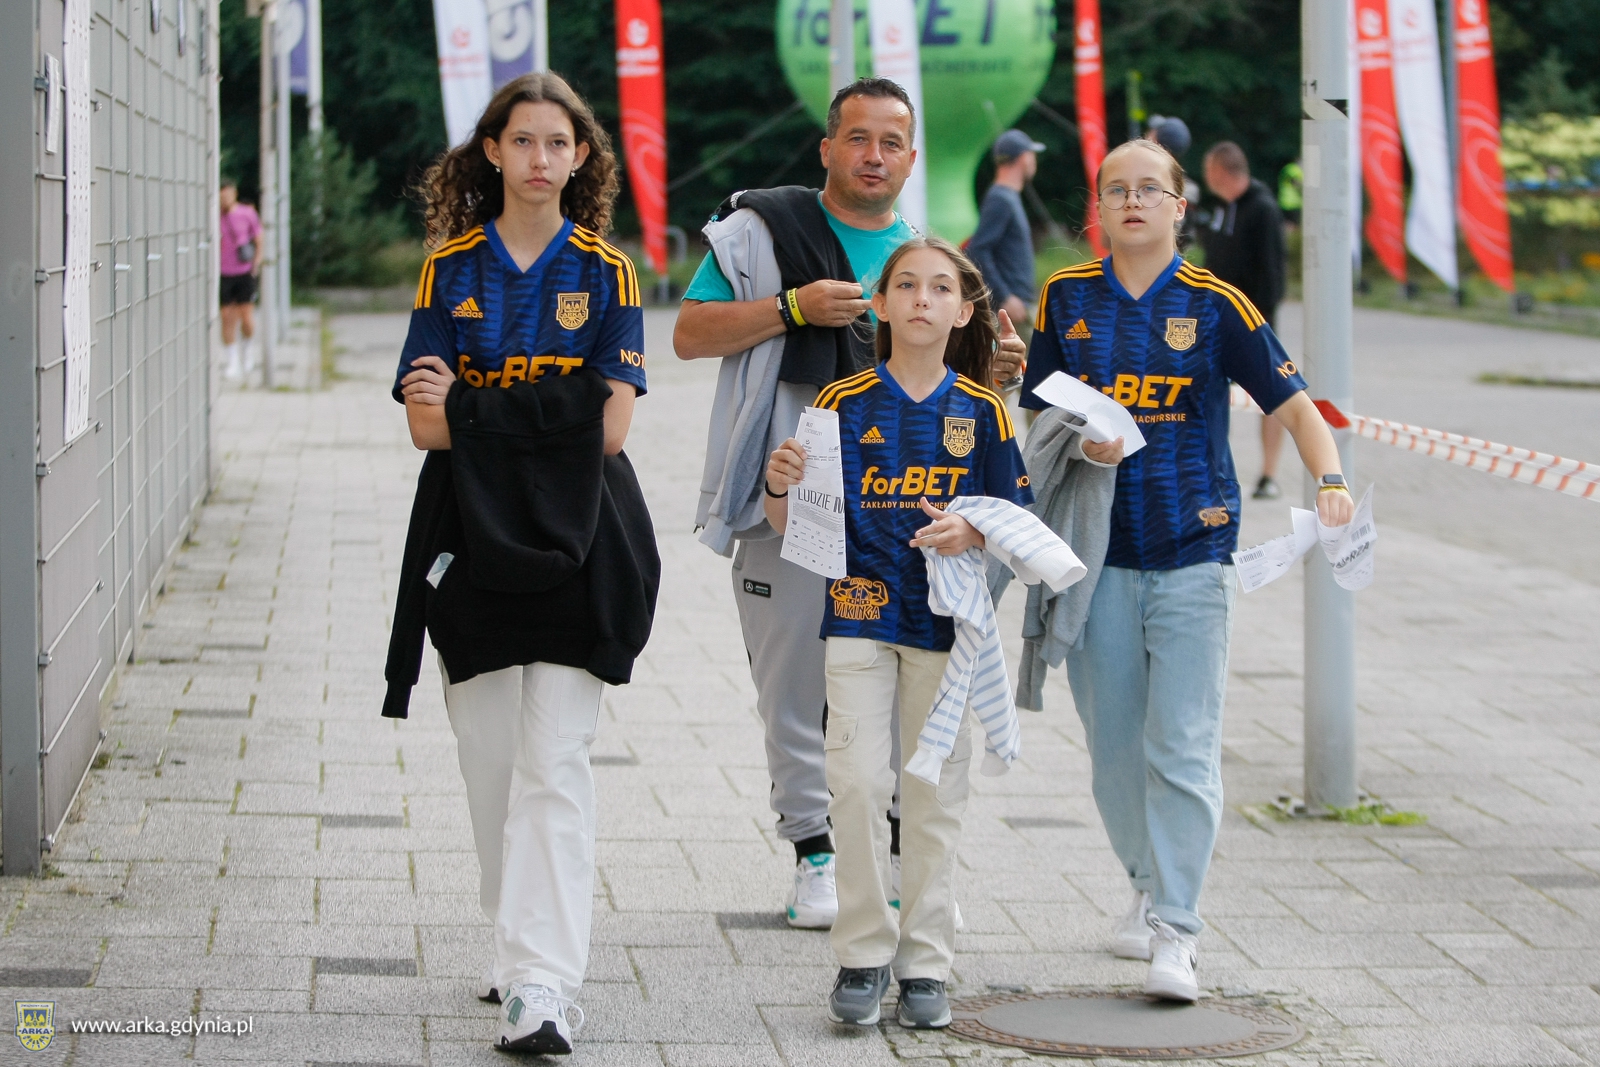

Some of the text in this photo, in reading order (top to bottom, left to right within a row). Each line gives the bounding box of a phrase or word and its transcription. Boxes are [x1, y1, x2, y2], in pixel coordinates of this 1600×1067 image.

[452, 310, 484, 319] adidas
[1065, 332, 1092, 340] adidas
[1079, 373, 1193, 408] rBET
[860, 466, 970, 496] forBET
[797, 487, 831, 511] LUDZIE
[860, 501, 949, 510] ZAKŁADY BUKMCHER
